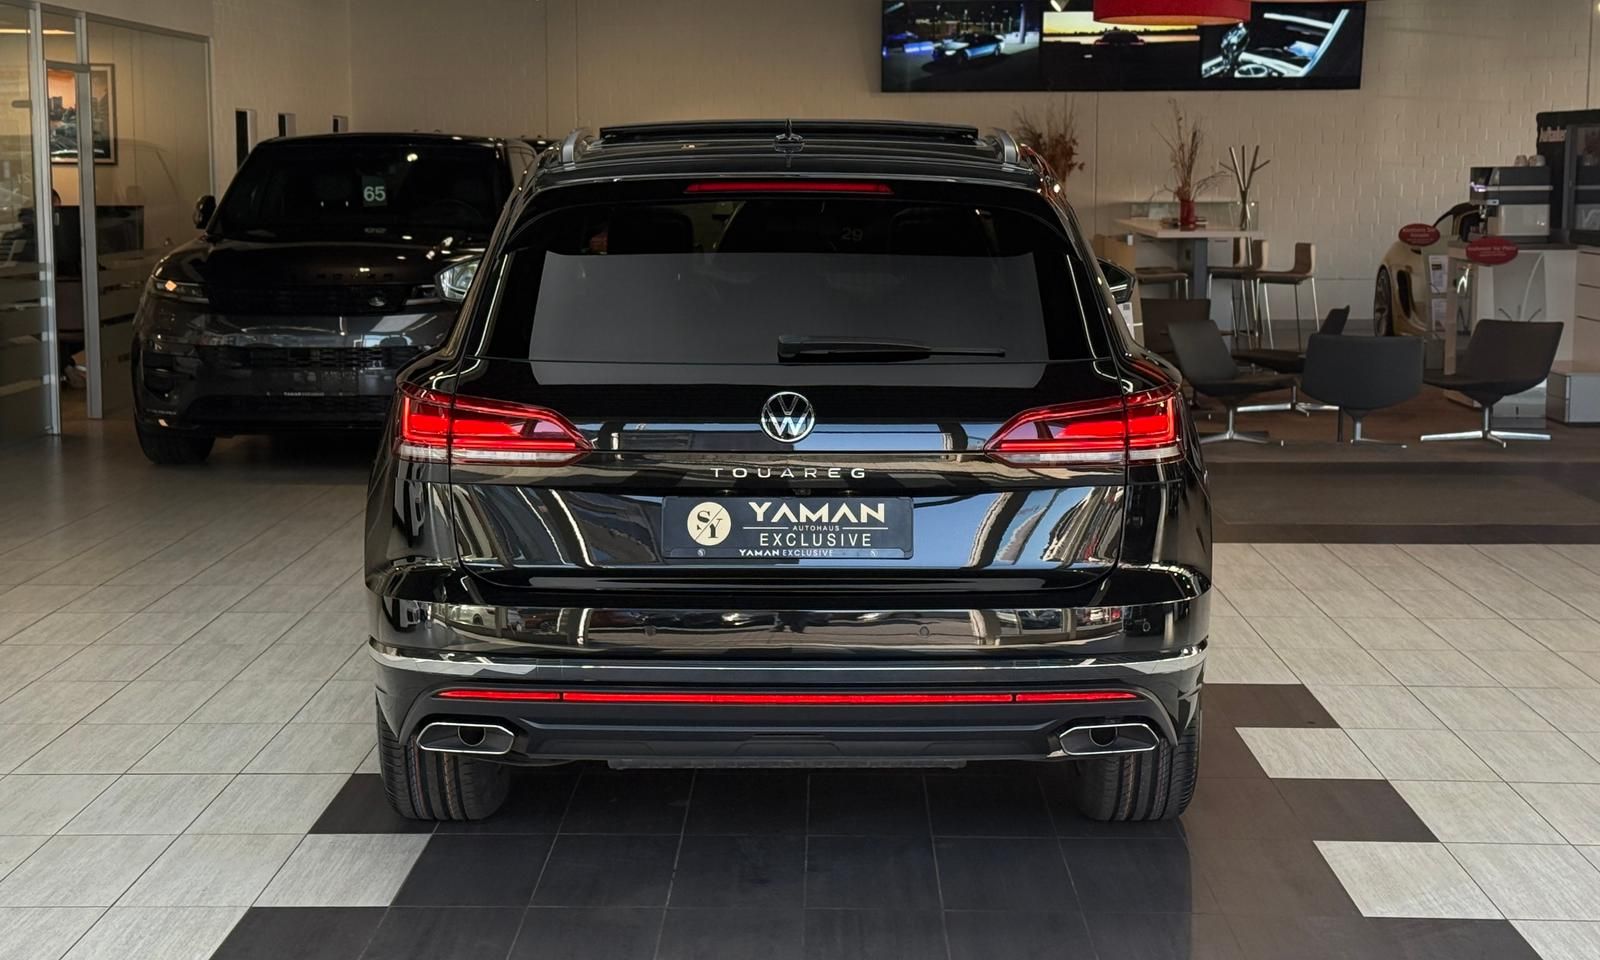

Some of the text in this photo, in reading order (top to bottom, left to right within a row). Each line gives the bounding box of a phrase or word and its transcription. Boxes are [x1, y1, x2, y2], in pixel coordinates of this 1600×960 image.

[363, 185, 386, 202] 65
[711, 467, 866, 479] TOUAREG
[748, 501, 885, 523] YAMAN
[759, 533, 872, 547] EXCLUSIVE
[739, 549, 834, 557] YAMAN EXCLUSIVE
